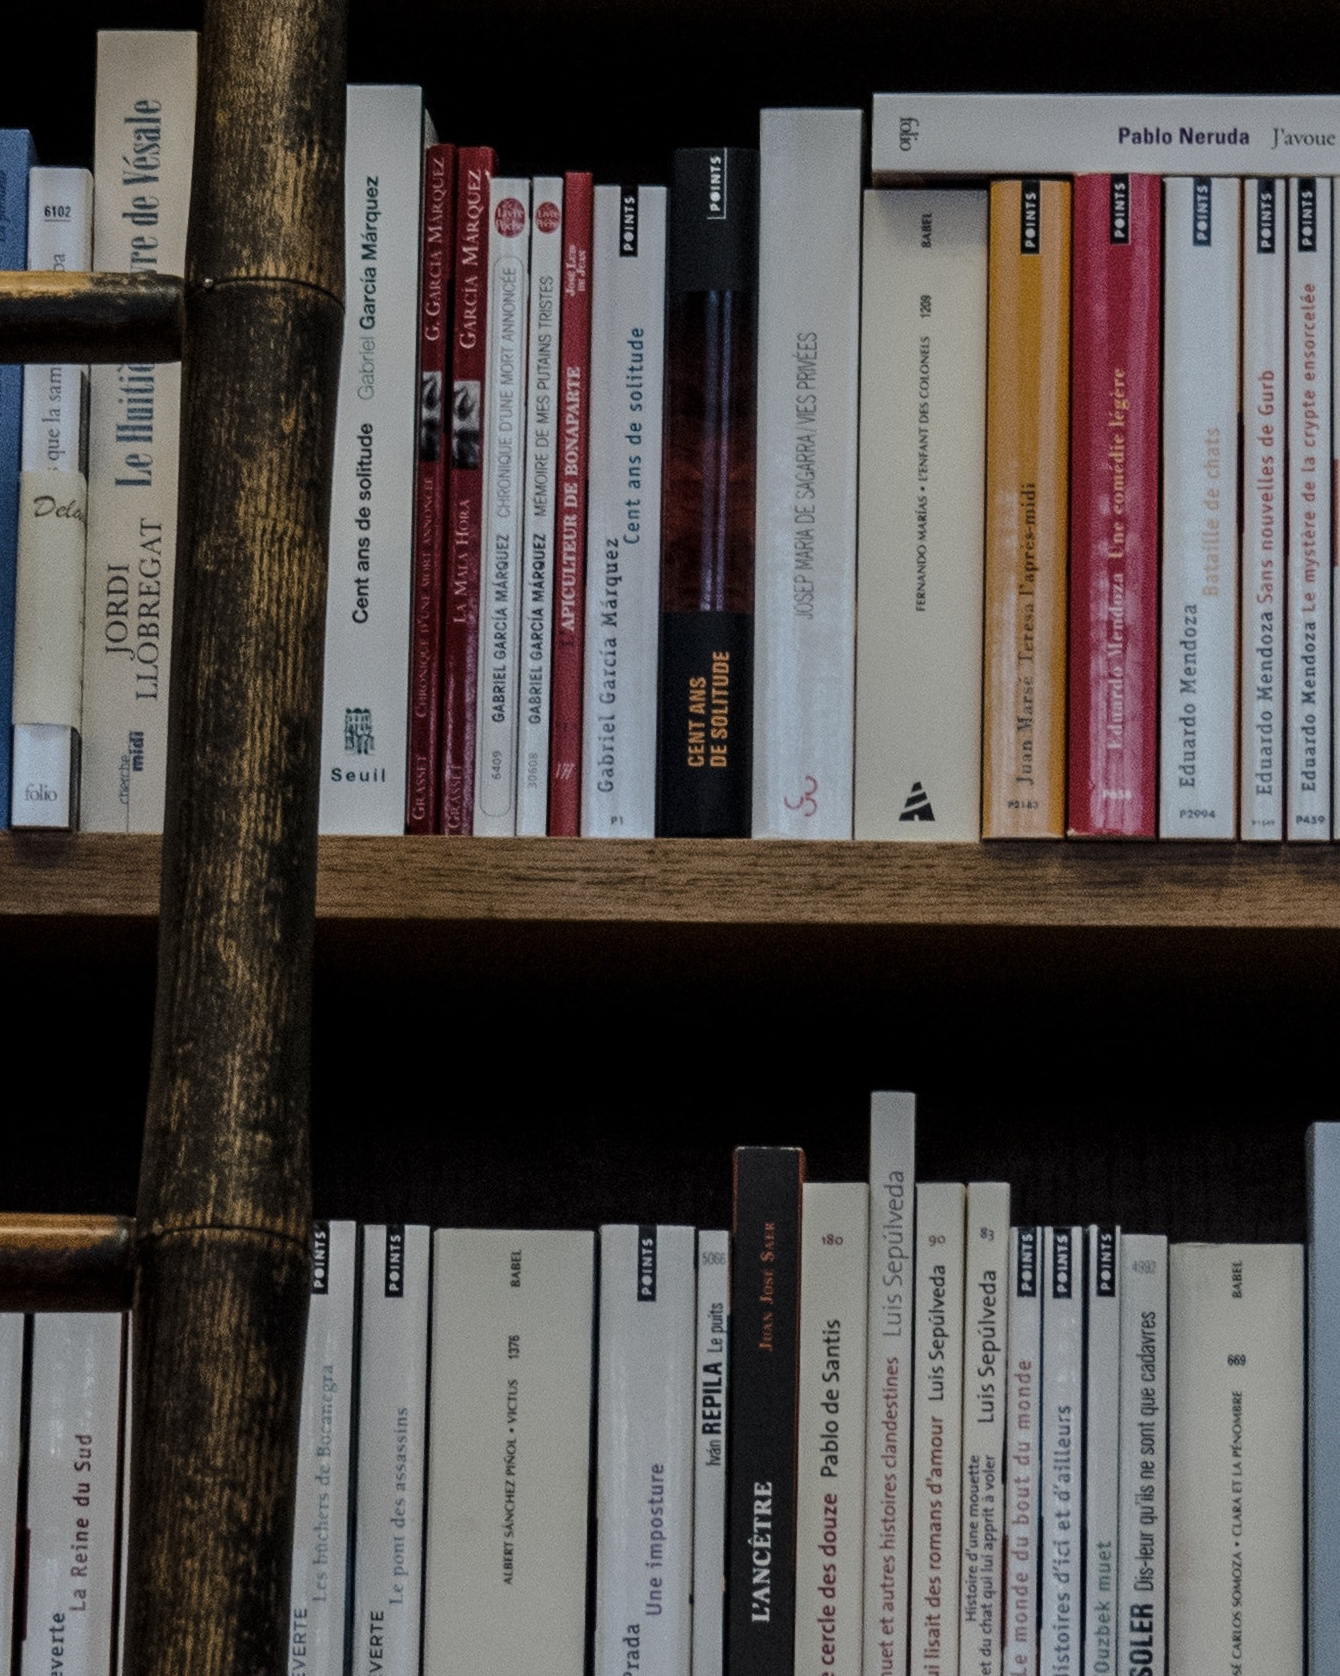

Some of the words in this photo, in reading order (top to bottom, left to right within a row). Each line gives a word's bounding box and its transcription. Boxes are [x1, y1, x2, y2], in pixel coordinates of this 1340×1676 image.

[1118, 127, 1172, 144] Pablo
[1179, 127, 1249, 144] Neruda
[361, 176, 381, 260] Márquez
[623, 195, 636, 252] POINTS
[359, 267, 376, 330] García
[357, 336, 375, 400] Gabriel
[356, 423, 373, 501] solitude
[355, 507, 371, 531] de
[357, 537, 370, 572] ans
[105, 565, 135, 660] JORDI
[135, 517, 163, 700] LLOBREGAT
[352, 578, 369, 624] Cent
[689, 677, 707, 714] ANS
[710, 651, 730, 739] SOLITUDE
[687, 720, 705, 767] CENT
[709, 745, 727, 767] DE
[880, 1170, 910, 1286] Sepúlveda
[510, 1250, 521, 1288] BABEL
[706, 1302, 726, 1333] puits
[883, 1294, 902, 1336] Luis
[508, 1335, 520, 1359] 1376
[707, 1335, 723, 1353] Le
[507, 1379, 518, 1424] VICTUS
[702, 1362, 722, 1435] REPILA
[73, 1434, 92, 1472] Sud
[504, 1439, 516, 1476] PIÑOL
[705, 1441, 721, 1466] Iván
[72, 1483, 90, 1507] du
[503, 1480, 516, 1538] SÁNCHEZ
[71, 1518, 89, 1577] Reine
[503, 1542, 513, 1584] ALBERT
[69, 1589, 87, 1611] La
